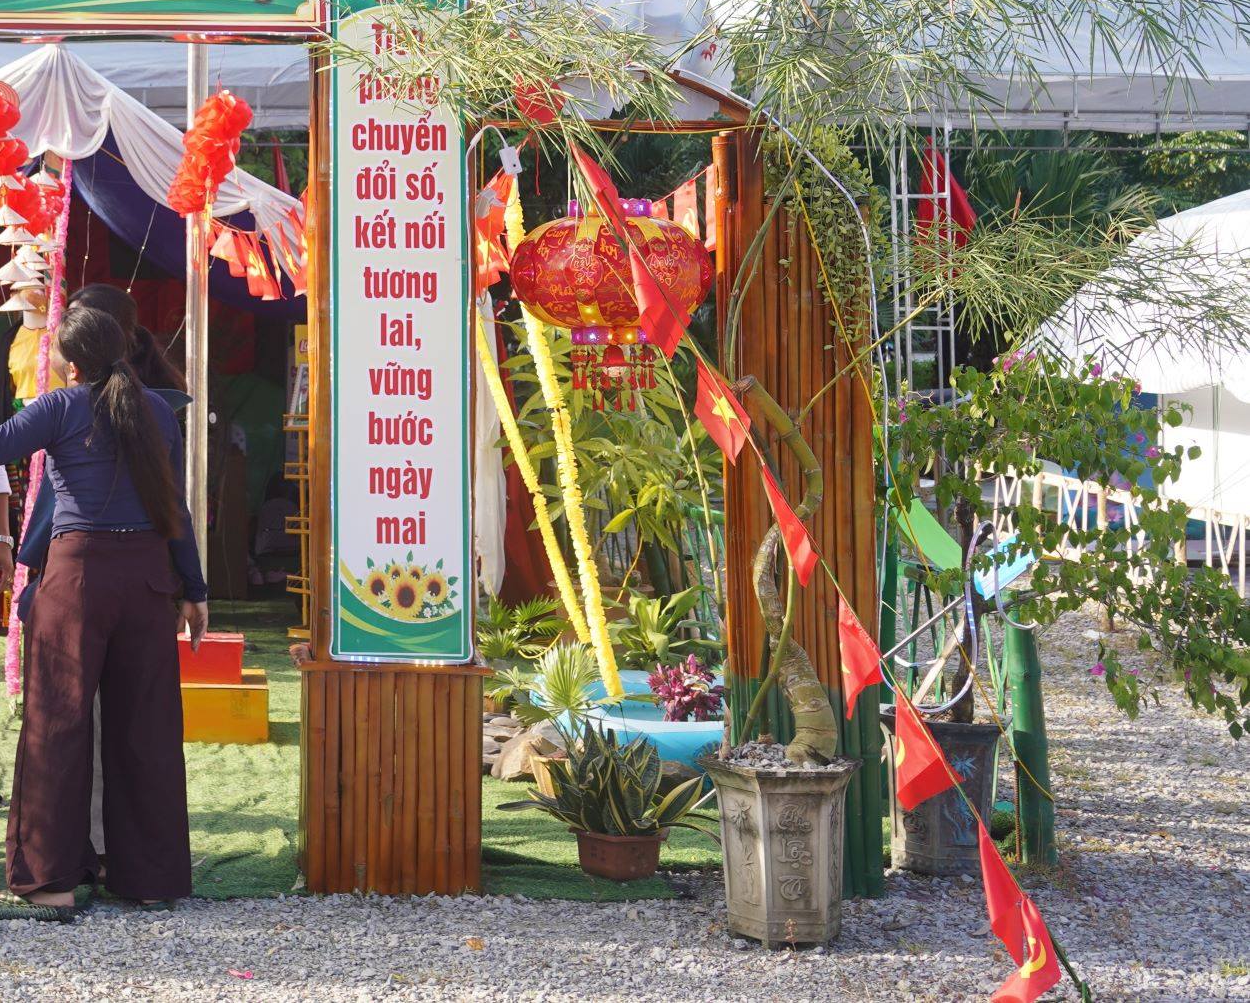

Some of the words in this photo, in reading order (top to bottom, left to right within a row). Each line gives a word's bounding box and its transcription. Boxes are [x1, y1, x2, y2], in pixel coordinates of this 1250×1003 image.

[352, 110, 447, 155] chuyển
[356, 159, 396, 200] đổi
[405, 162, 444, 205] số,
[354, 209, 397, 249] kết
[405, 210, 445, 249] nối
[363, 266, 438, 303] tương
[380, 313, 421, 350] lai,
[369, 361, 433, 400] vững
[368, 410, 433, 446] bước
[369, 460, 433, 498] ngày
[376, 511, 426, 545] mai
